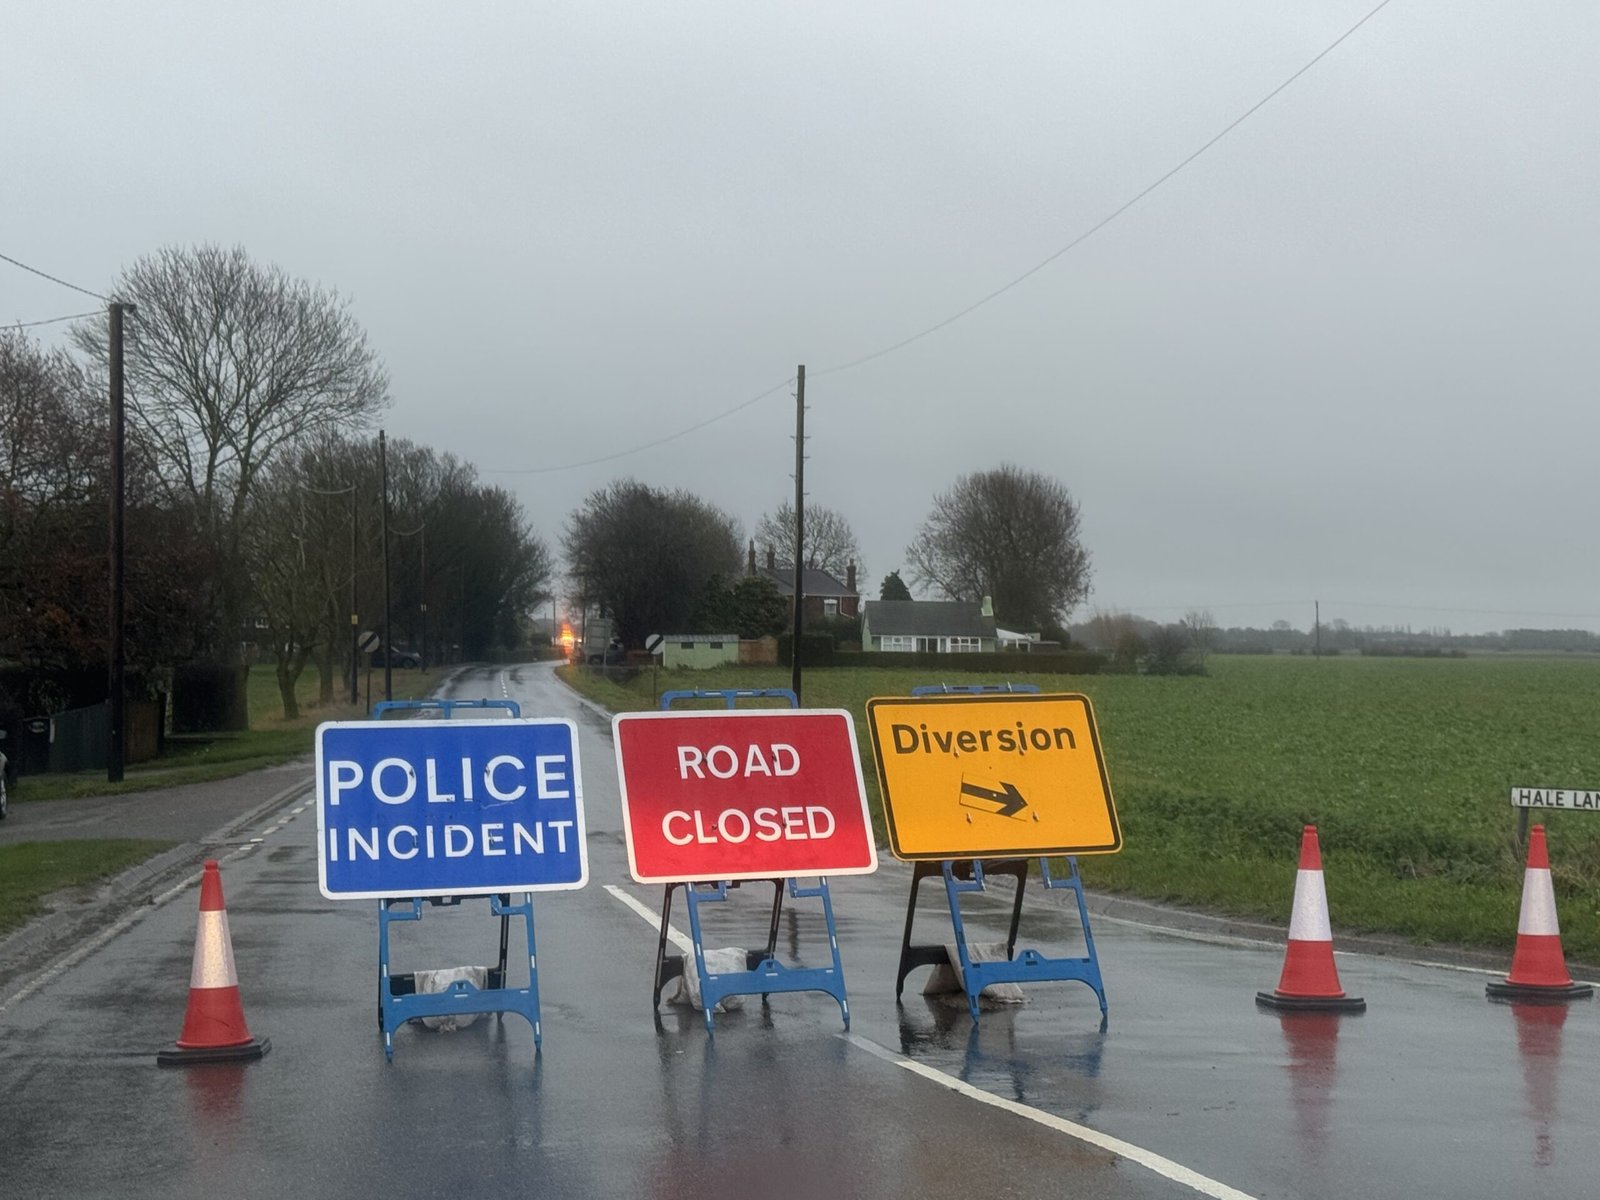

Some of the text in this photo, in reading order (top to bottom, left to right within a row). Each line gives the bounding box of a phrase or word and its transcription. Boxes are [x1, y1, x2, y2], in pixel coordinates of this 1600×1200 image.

[893, 721, 1078, 754] Diversion
[329, 755, 570, 805] POLICE
[677, 743, 801, 780] ROAD
[1519, 789, 1565, 807] HALE
[329, 820, 574, 862] INCIDENT
[661, 805, 836, 846] CLOSED
